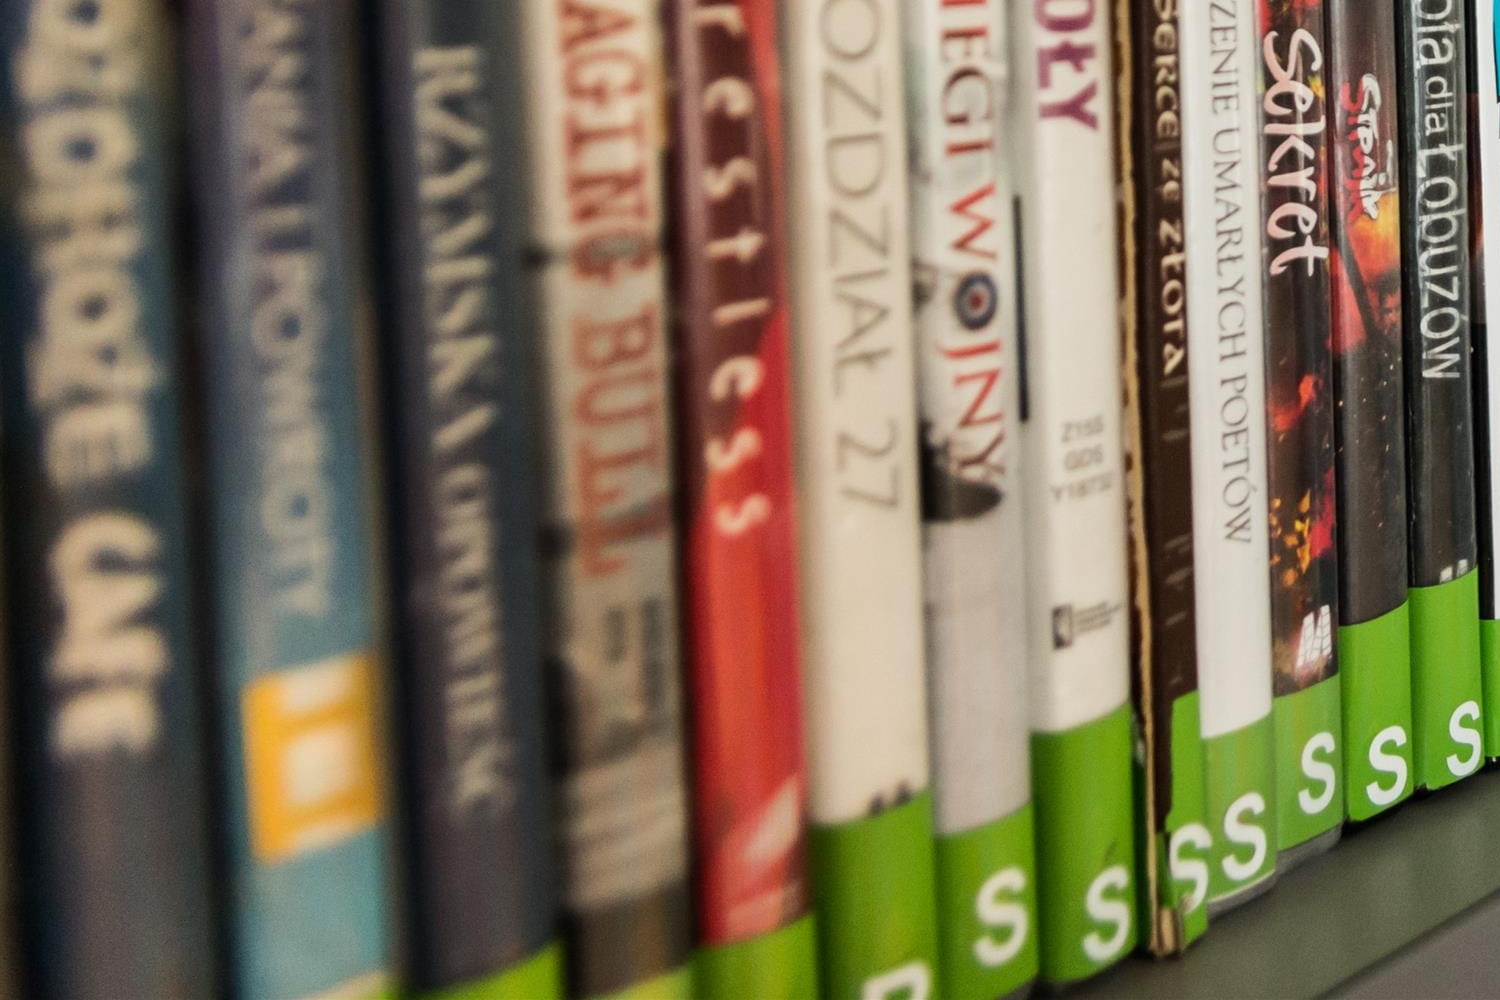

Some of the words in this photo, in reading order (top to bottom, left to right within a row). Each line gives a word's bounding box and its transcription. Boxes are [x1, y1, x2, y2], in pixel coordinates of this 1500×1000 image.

[1263, 29, 1328, 278] Sekret
[1424, 75, 1453, 138] dla
[411, 44, 497, 453] RZYMSKA
[697, 3, 772, 538] restless
[1213, 127, 1246, 363] UMARŁYCH
[1416, 143, 1469, 380] Łobuzów
[572, 302, 672, 582] BULL
[837, 418, 899, 512] 27
[1220, 373, 1257, 544] POETÓW
[1298, 731, 1336, 815] S
[1365, 724, 1408, 806] S
[1446, 699, 1481, 777] S
[1169, 823, 1213, 914] S
[1221, 791, 1267, 881] S
[974, 866, 1028, 968] S
[1083, 865, 1130, 961] S
